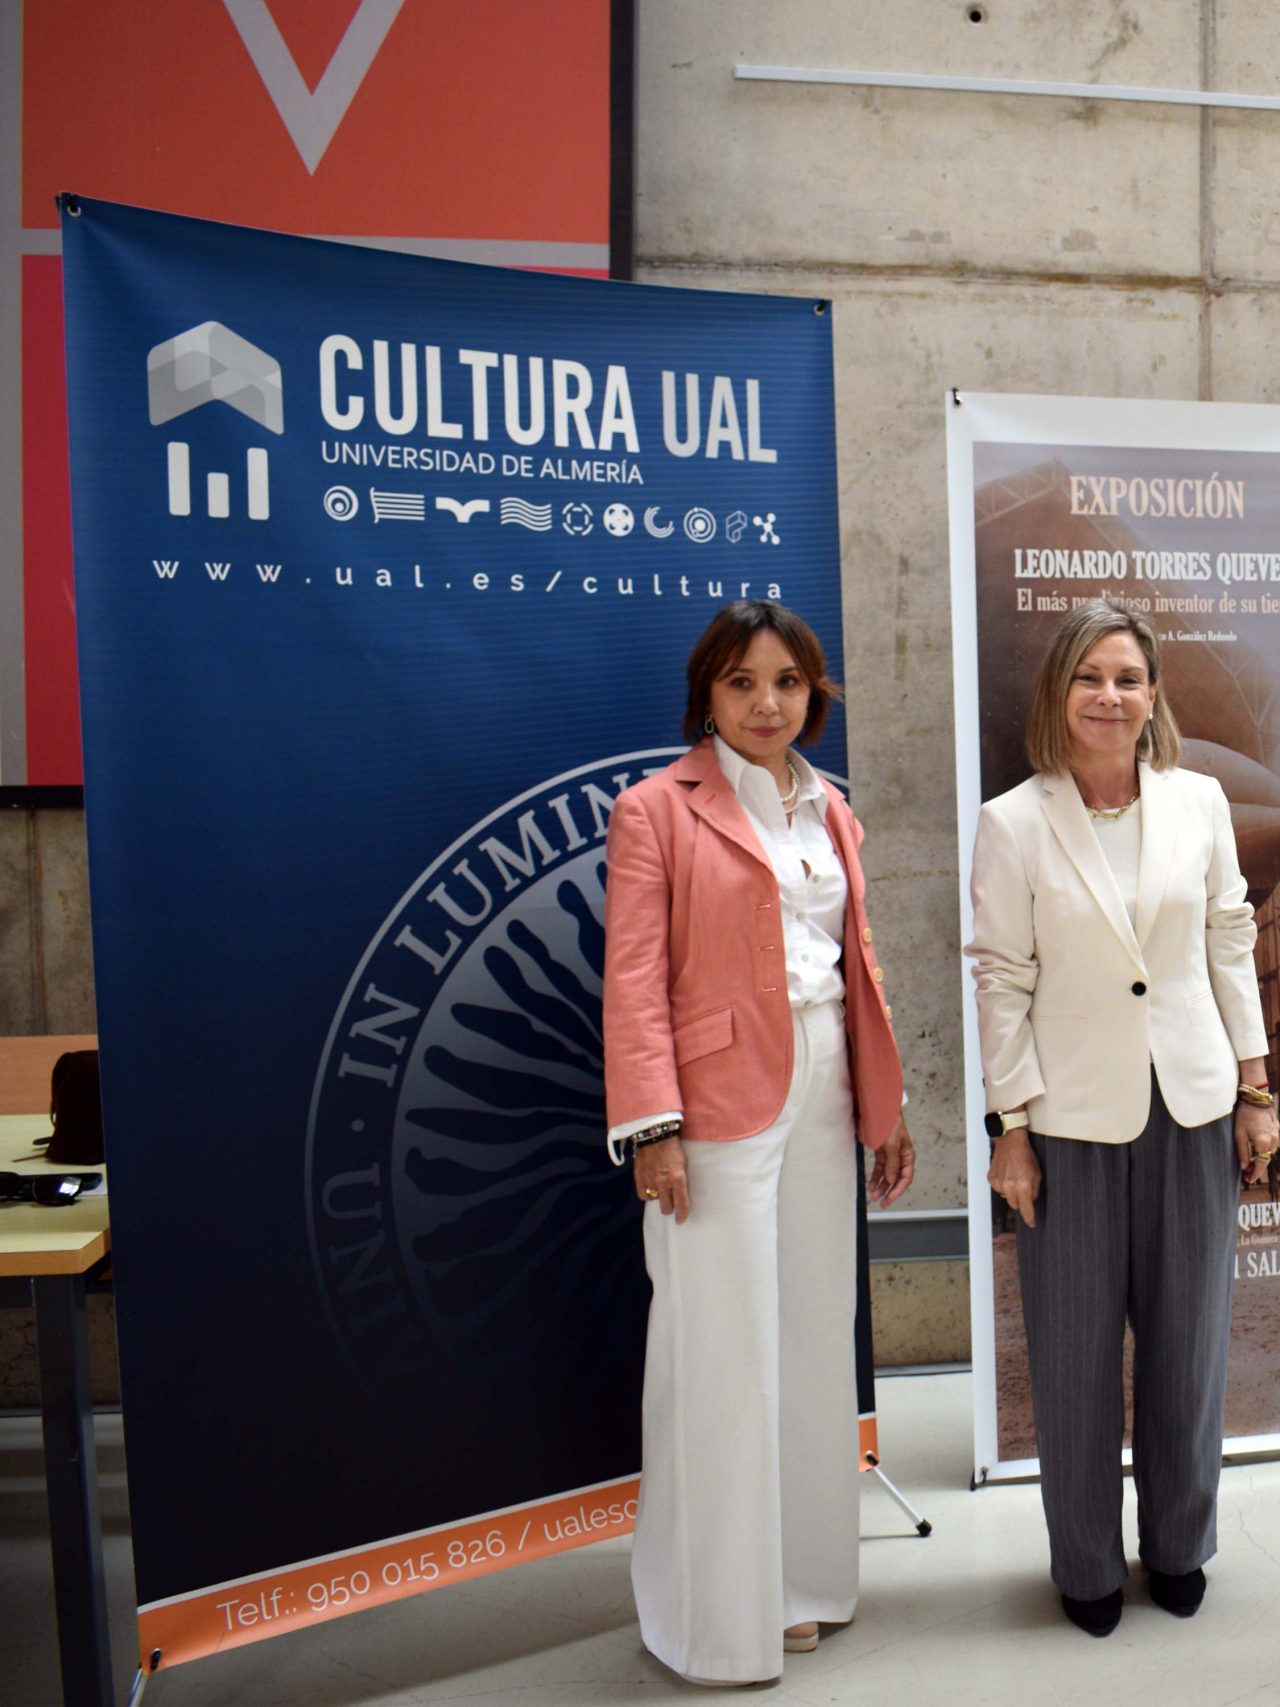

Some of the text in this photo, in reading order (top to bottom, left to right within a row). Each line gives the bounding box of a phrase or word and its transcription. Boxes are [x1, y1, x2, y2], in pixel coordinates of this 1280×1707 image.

[318, 332, 778, 463] CULTURA UAL
[321, 440, 645, 485] UNIVERSIDAD DE ALMERÍA
[1069, 471, 1245, 519] EXPOSICIÓN
[1014, 548, 1127, 580] LEONARDO
[1132, 551, 1211, 580] TORRES
[1016, 587, 1032, 612] El
[1037, 593, 1068, 612] más
[1155, 591, 1214, 613] inventor
[1219, 591, 1237, 612] de
[1240, 596, 1257, 613] su
[1176, 630, 1207, 642] González
[1207, 630, 1238, 642] Redondo
[337, 982, 421, 1089] IN
[215, 1587, 298, 1633] Telf.:
[306, 1570, 370, 1613] 950
[381, 1552, 440, 1587] 015
[447, 1529, 506, 1569] 826
